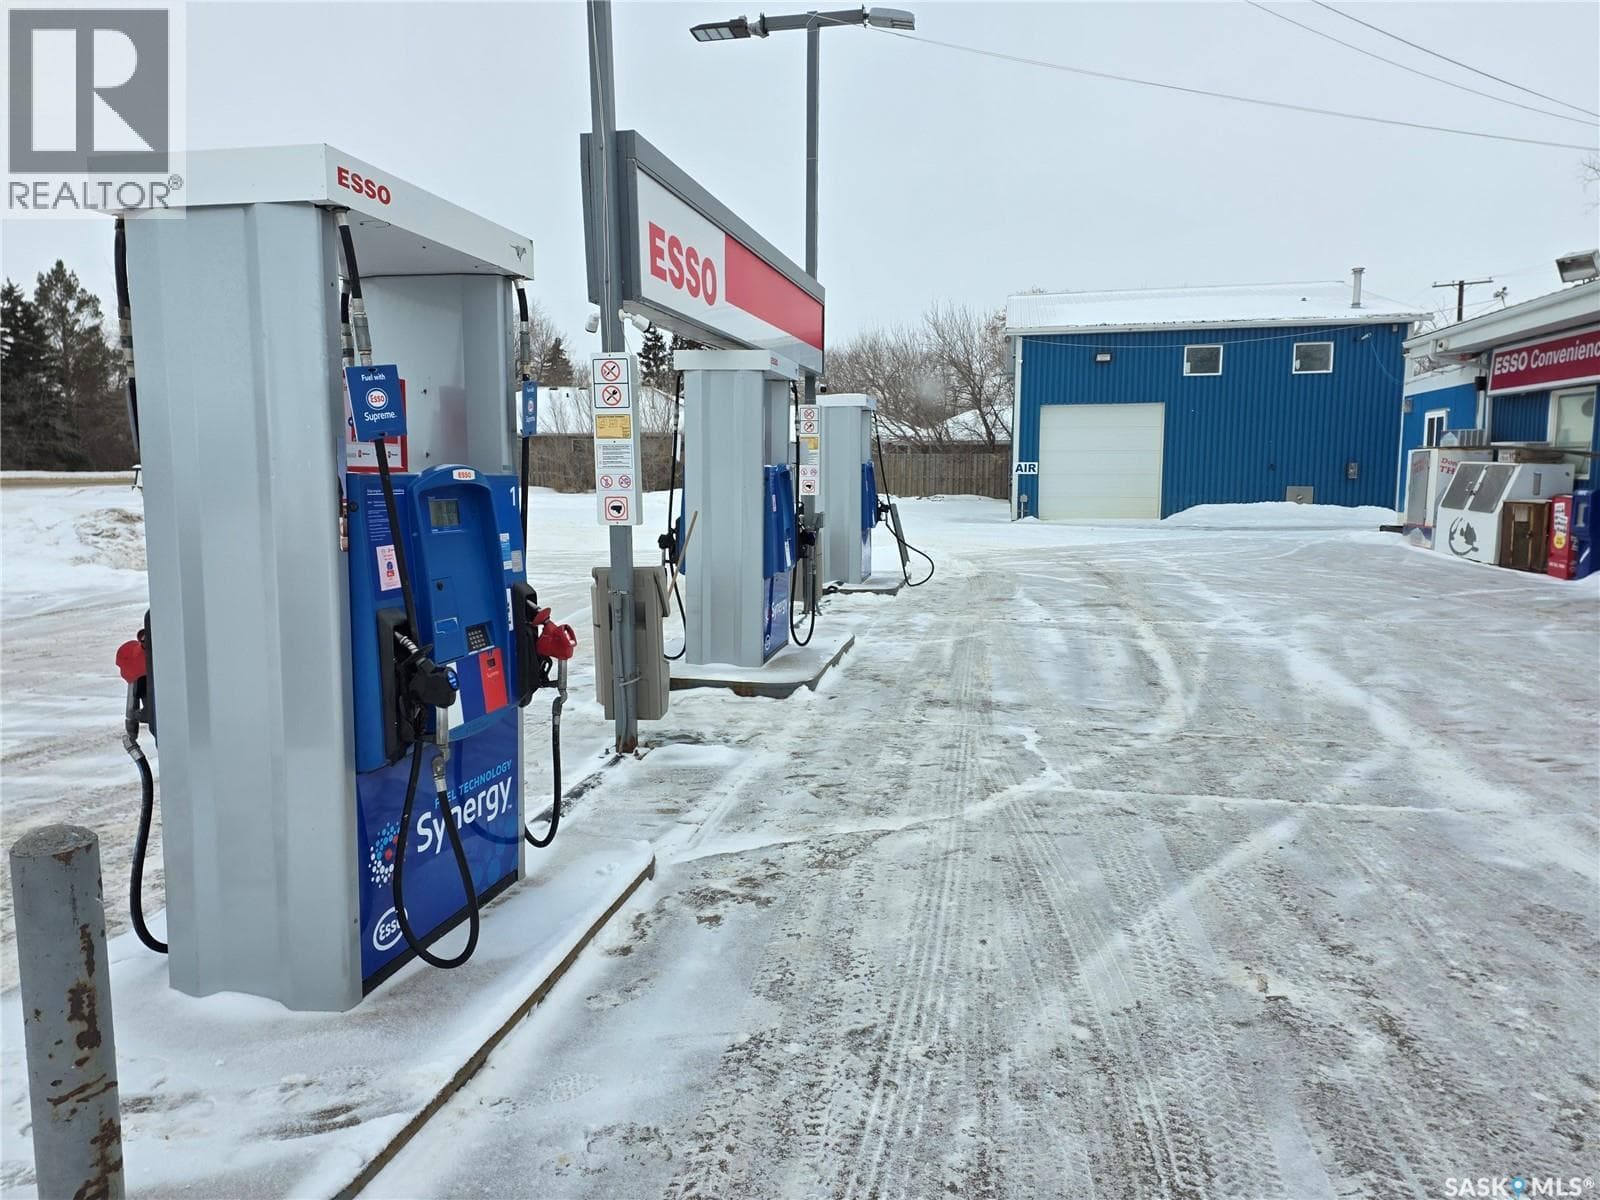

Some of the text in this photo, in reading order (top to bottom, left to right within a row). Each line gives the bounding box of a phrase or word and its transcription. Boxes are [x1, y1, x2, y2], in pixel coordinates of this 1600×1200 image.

[337, 166, 391, 204] ESSO
[649, 221, 717, 306] ESSO
[1494, 352, 1528, 375] ESSO
[364, 411, 396, 423] Supreme
[1015, 463, 1037, 473] AIR
[510, 486, 516, 506] 1
[434, 760, 513, 810] FEL TECHNOLOGY
[416, 776, 513, 855] Synergy
